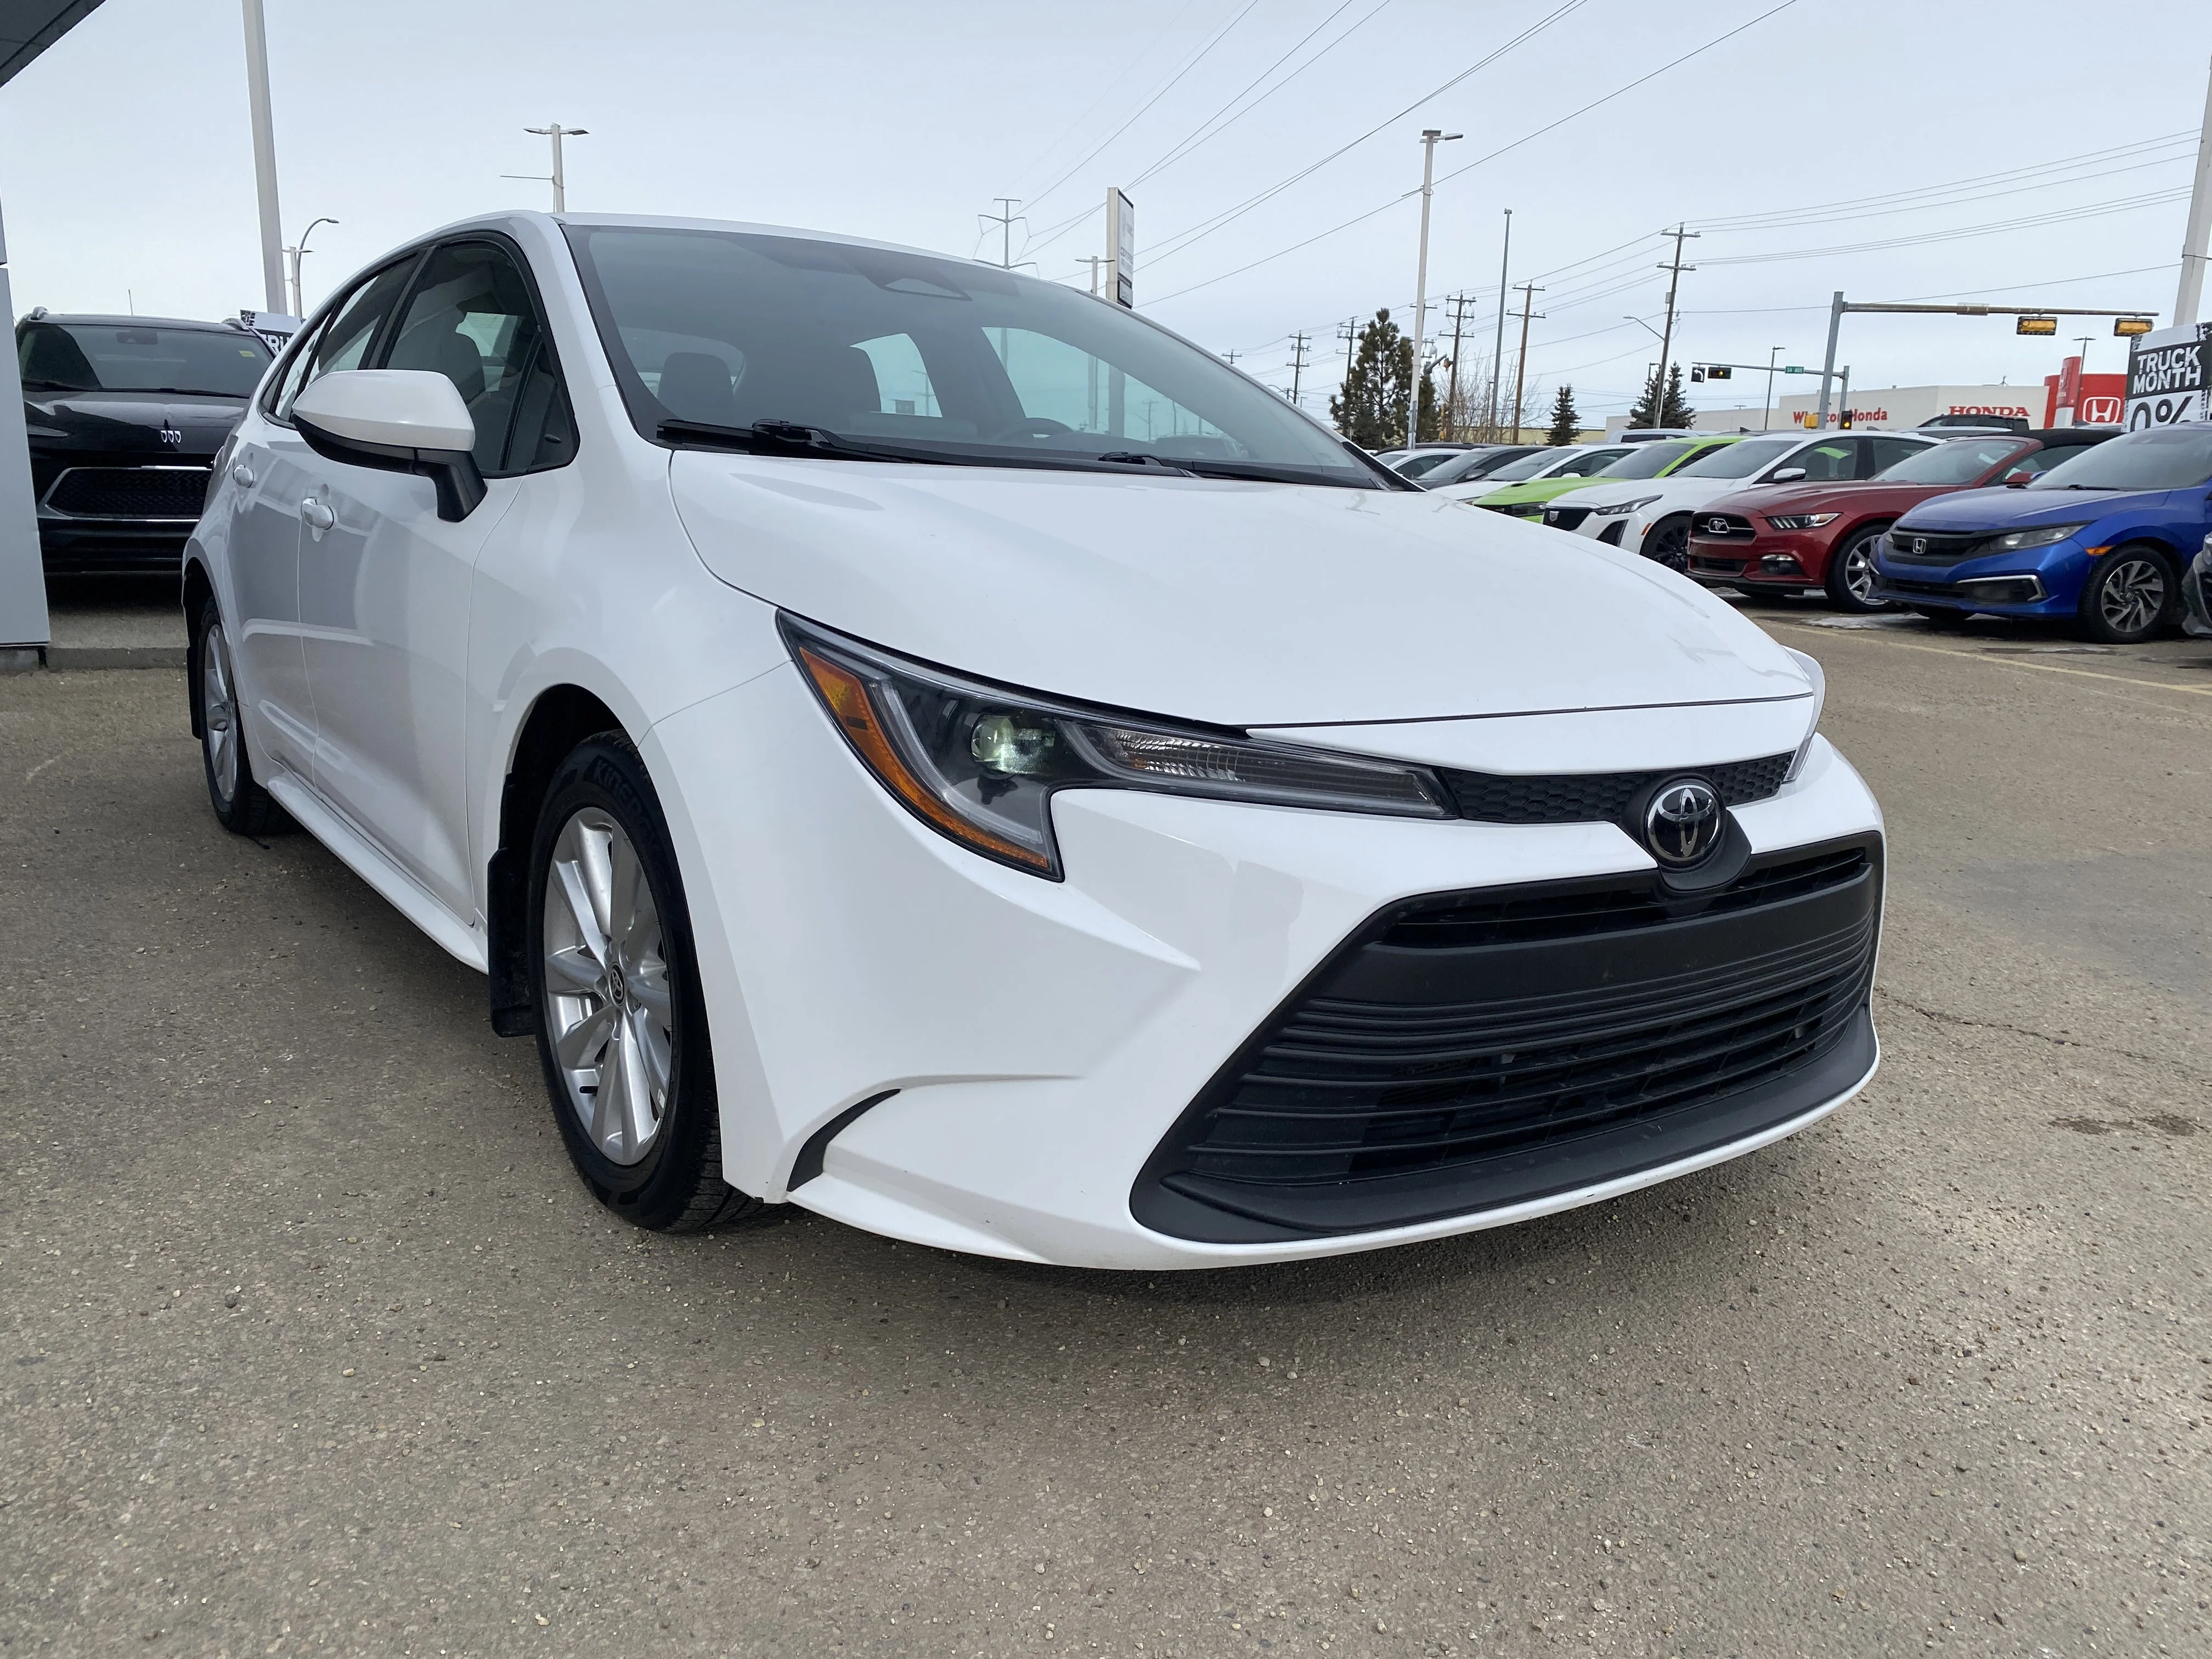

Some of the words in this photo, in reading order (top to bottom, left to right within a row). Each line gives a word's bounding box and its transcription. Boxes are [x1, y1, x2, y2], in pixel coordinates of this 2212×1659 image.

[2137, 345, 2202, 374] TRUCK
[2132, 365, 2202, 394] MONTH
[1849, 407, 1888, 421] Honda
[1949, 407, 2031, 416] HONDA
[2130, 396, 2193, 432] 0%
